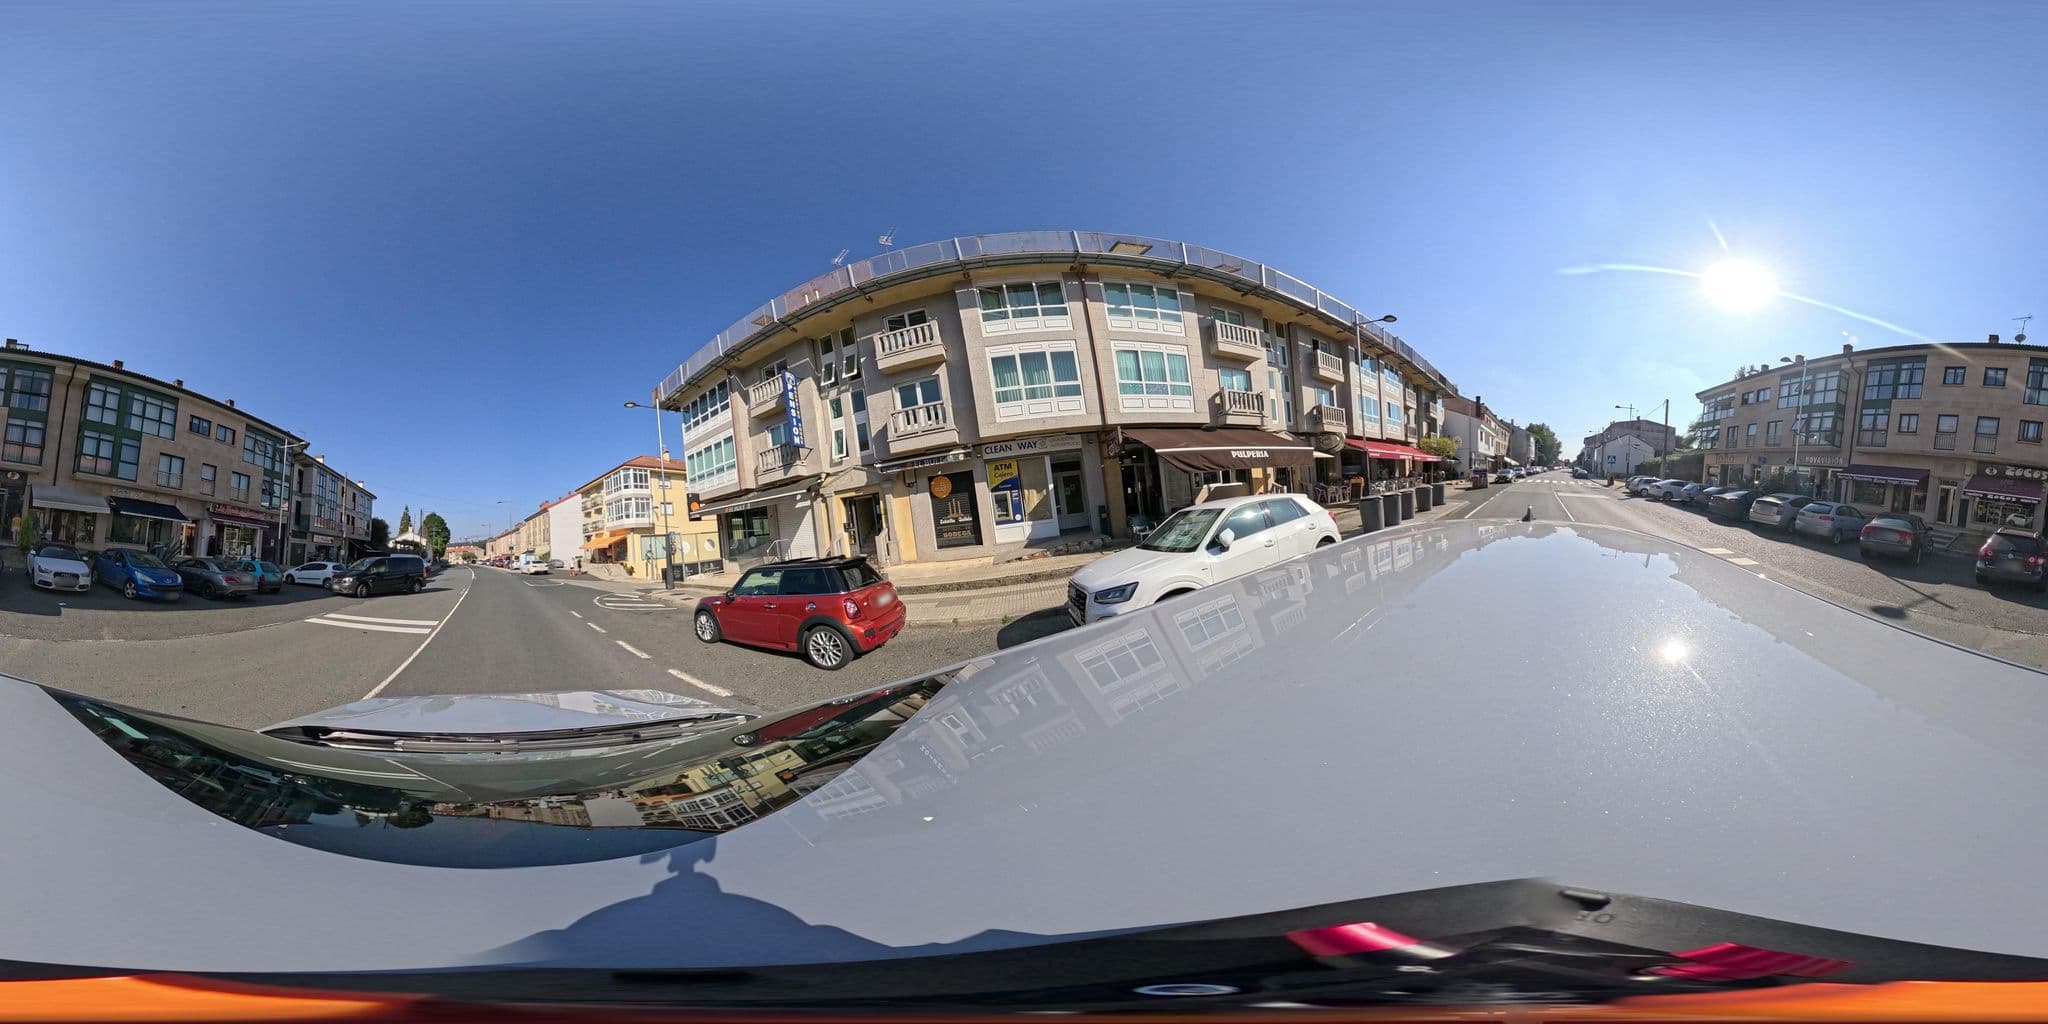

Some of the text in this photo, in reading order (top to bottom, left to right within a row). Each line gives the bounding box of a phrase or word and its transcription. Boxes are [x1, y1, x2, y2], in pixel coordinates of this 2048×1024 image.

[984, 444, 1012, 455] CLEAN
[1017, 440, 1038, 450] WAY
[1230, 450, 1269, 458] PULPERIA
[993, 462, 1012, 471] ATM
